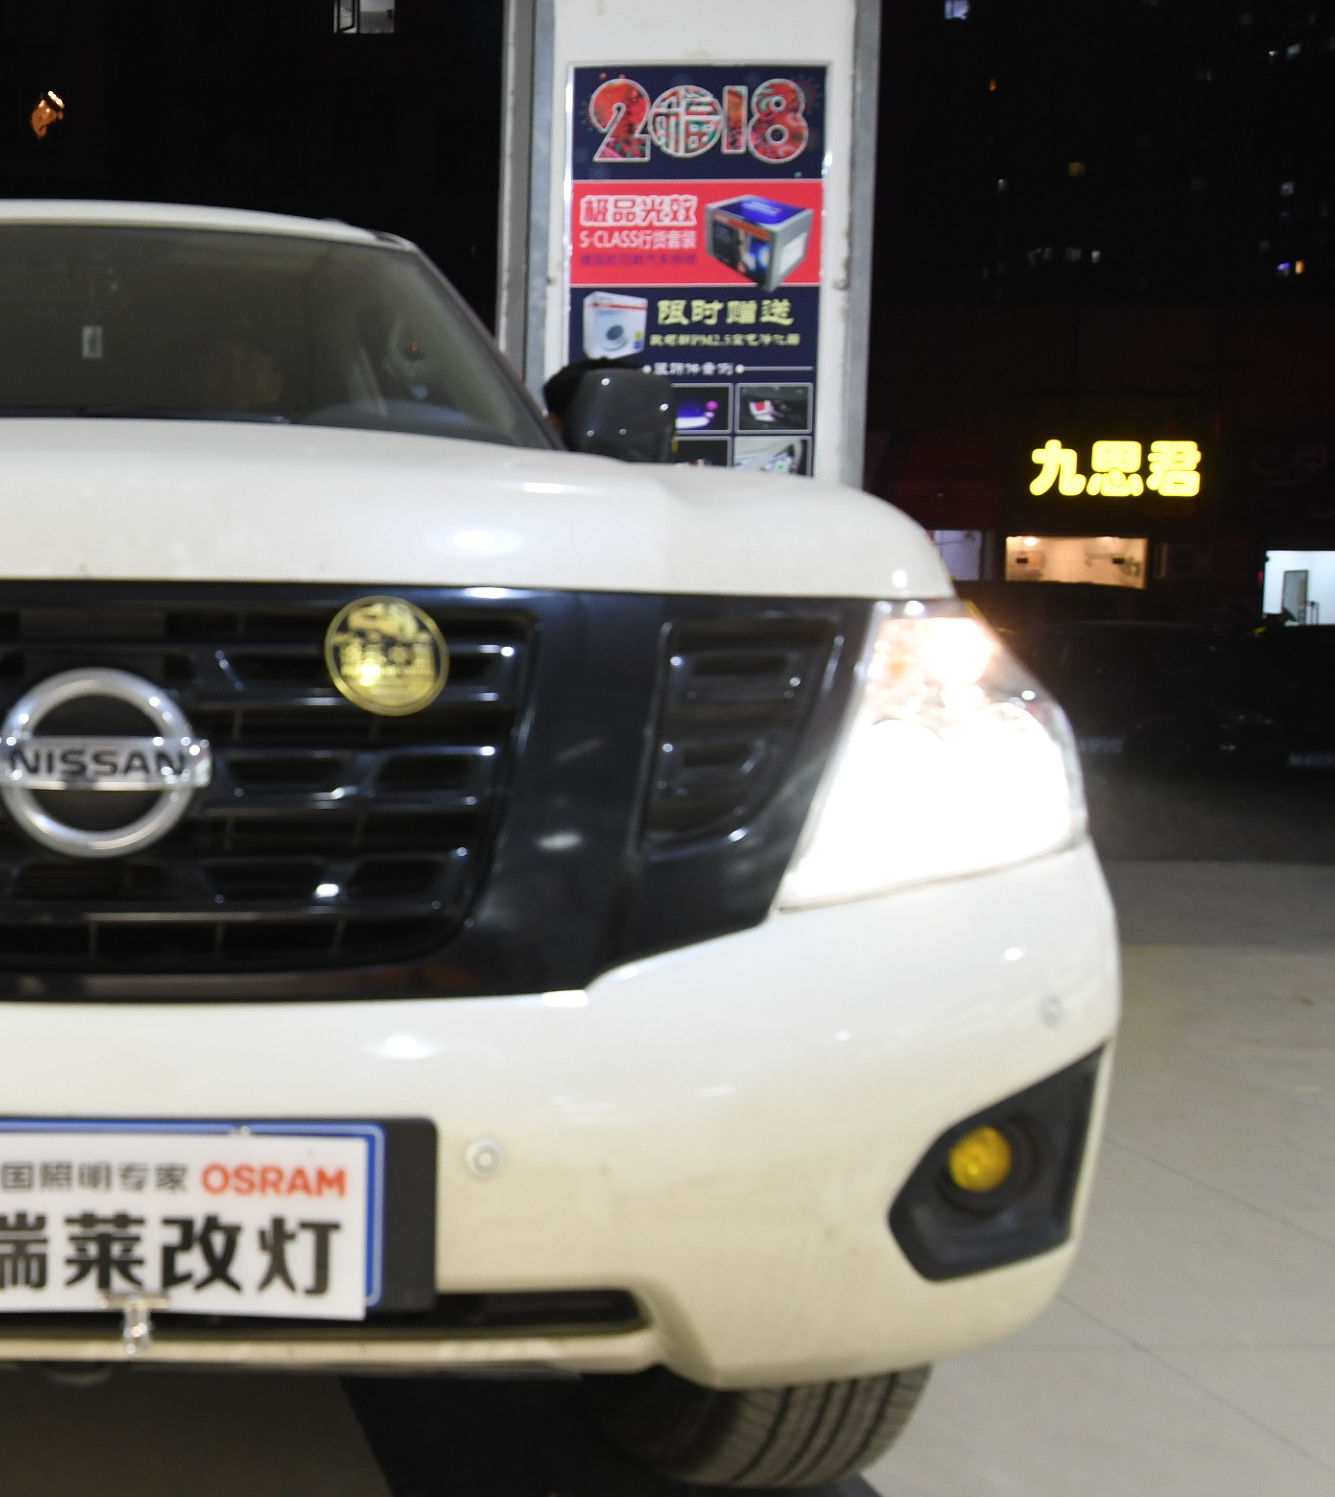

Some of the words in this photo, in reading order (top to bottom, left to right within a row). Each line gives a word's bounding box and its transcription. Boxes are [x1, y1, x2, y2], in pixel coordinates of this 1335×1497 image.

[657, 299, 794, 325] 限时赠送
[1029, 438, 1202, 497] 九思君
[11, 748, 185, 776] NISSAN
[202, 1163, 347, 1198] OSRAM
